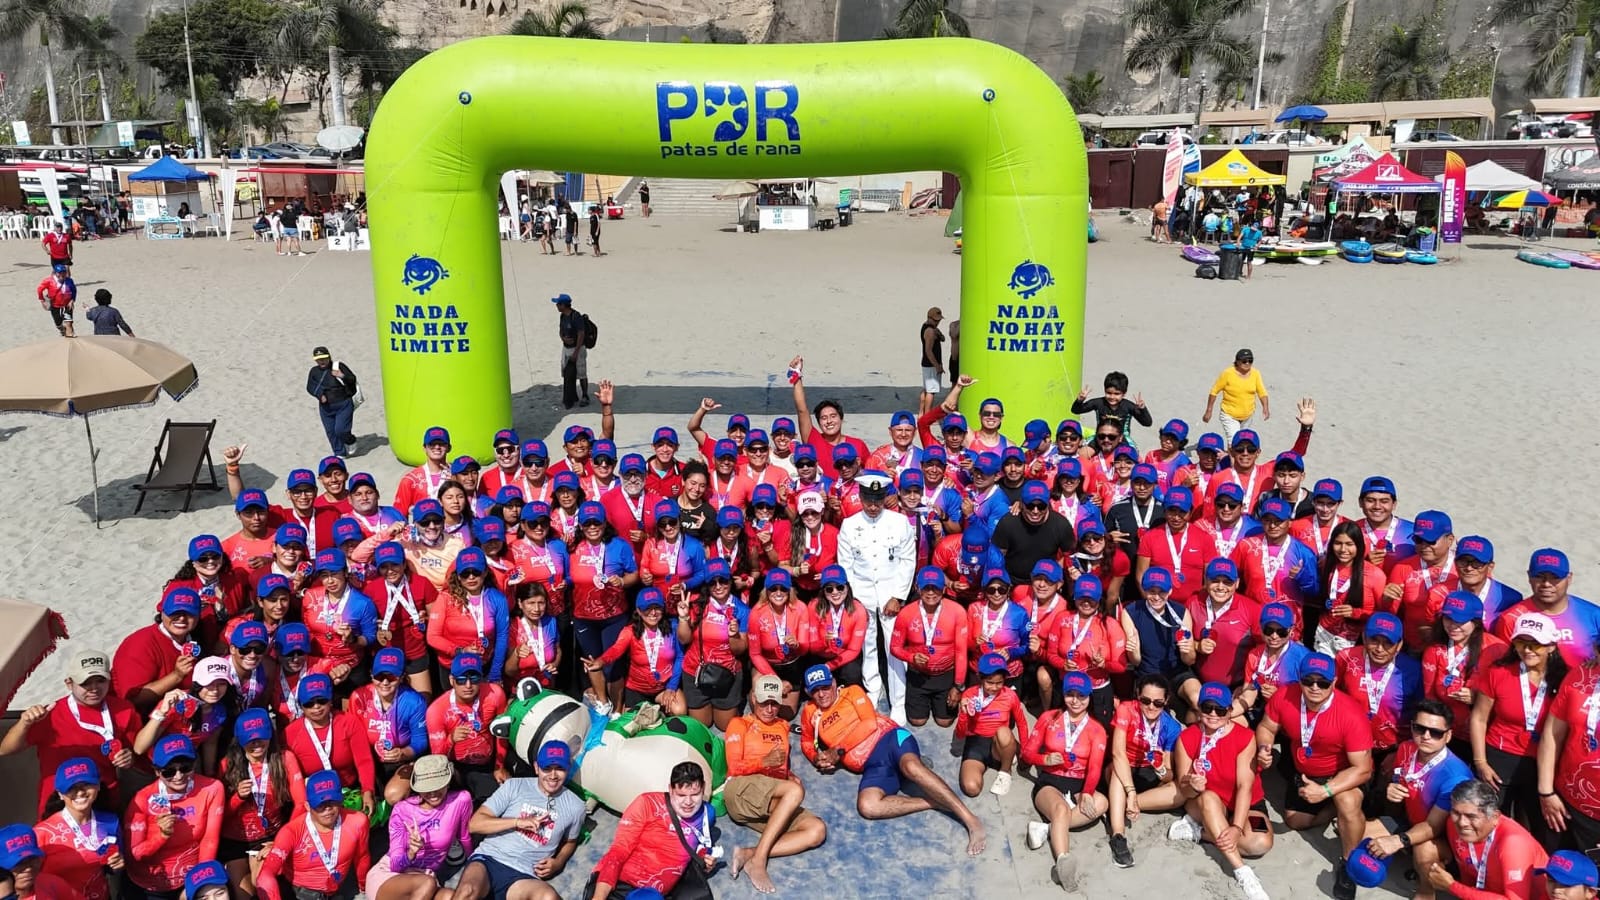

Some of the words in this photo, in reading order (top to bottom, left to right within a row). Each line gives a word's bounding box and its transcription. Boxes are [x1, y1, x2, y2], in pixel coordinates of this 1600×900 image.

[656, 80, 801, 142] PDR
[660, 142, 718, 160] patas
[725, 142, 749, 156] de
[755, 144, 802, 156] rana
[395, 304, 459, 319] NADA
[997, 304, 1059, 319] NADA
[390, 321, 416, 335] NO
[423, 322, 468, 336] HAY
[989, 320, 1019, 335] NO
[1024, 322, 1065, 336] HAY
[390, 338, 470, 353] LIMITE
[987, 337, 1065, 352] LIMITE
[421, 557, 442, 567] PDR
[1521, 619, 1544, 630] PDR
[81, 657, 104, 667] PDR
[207, 663, 228, 672] PDR
[807, 670, 826, 683] PDR
[763, 682, 779, 691] PDR
[821, 711, 840, 728] PDR
[762, 733, 783, 743] PDR
